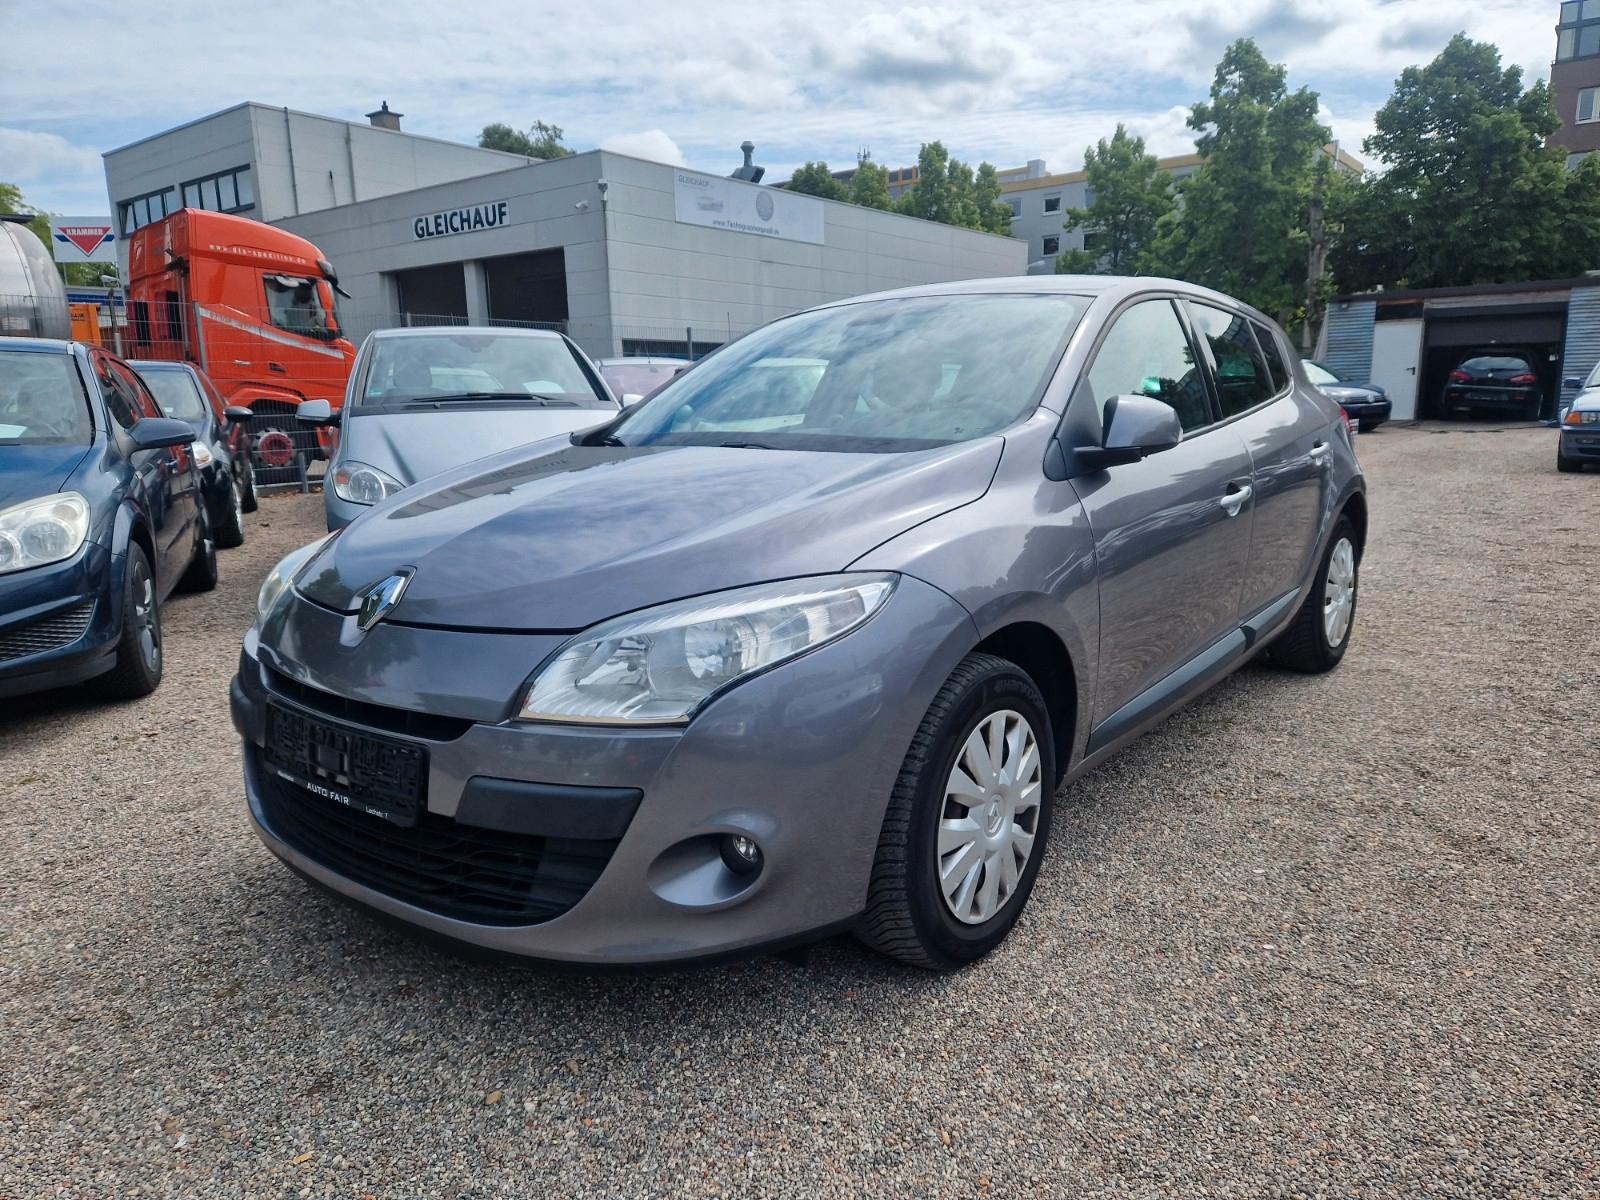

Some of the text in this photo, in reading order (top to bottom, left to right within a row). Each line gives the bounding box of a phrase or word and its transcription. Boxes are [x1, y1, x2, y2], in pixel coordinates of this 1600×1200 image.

[66, 228, 104, 236] KRAMMER
[414, 202, 508, 239] GLEICHAUF
[306, 782, 350, 806] AUTO FAIR
